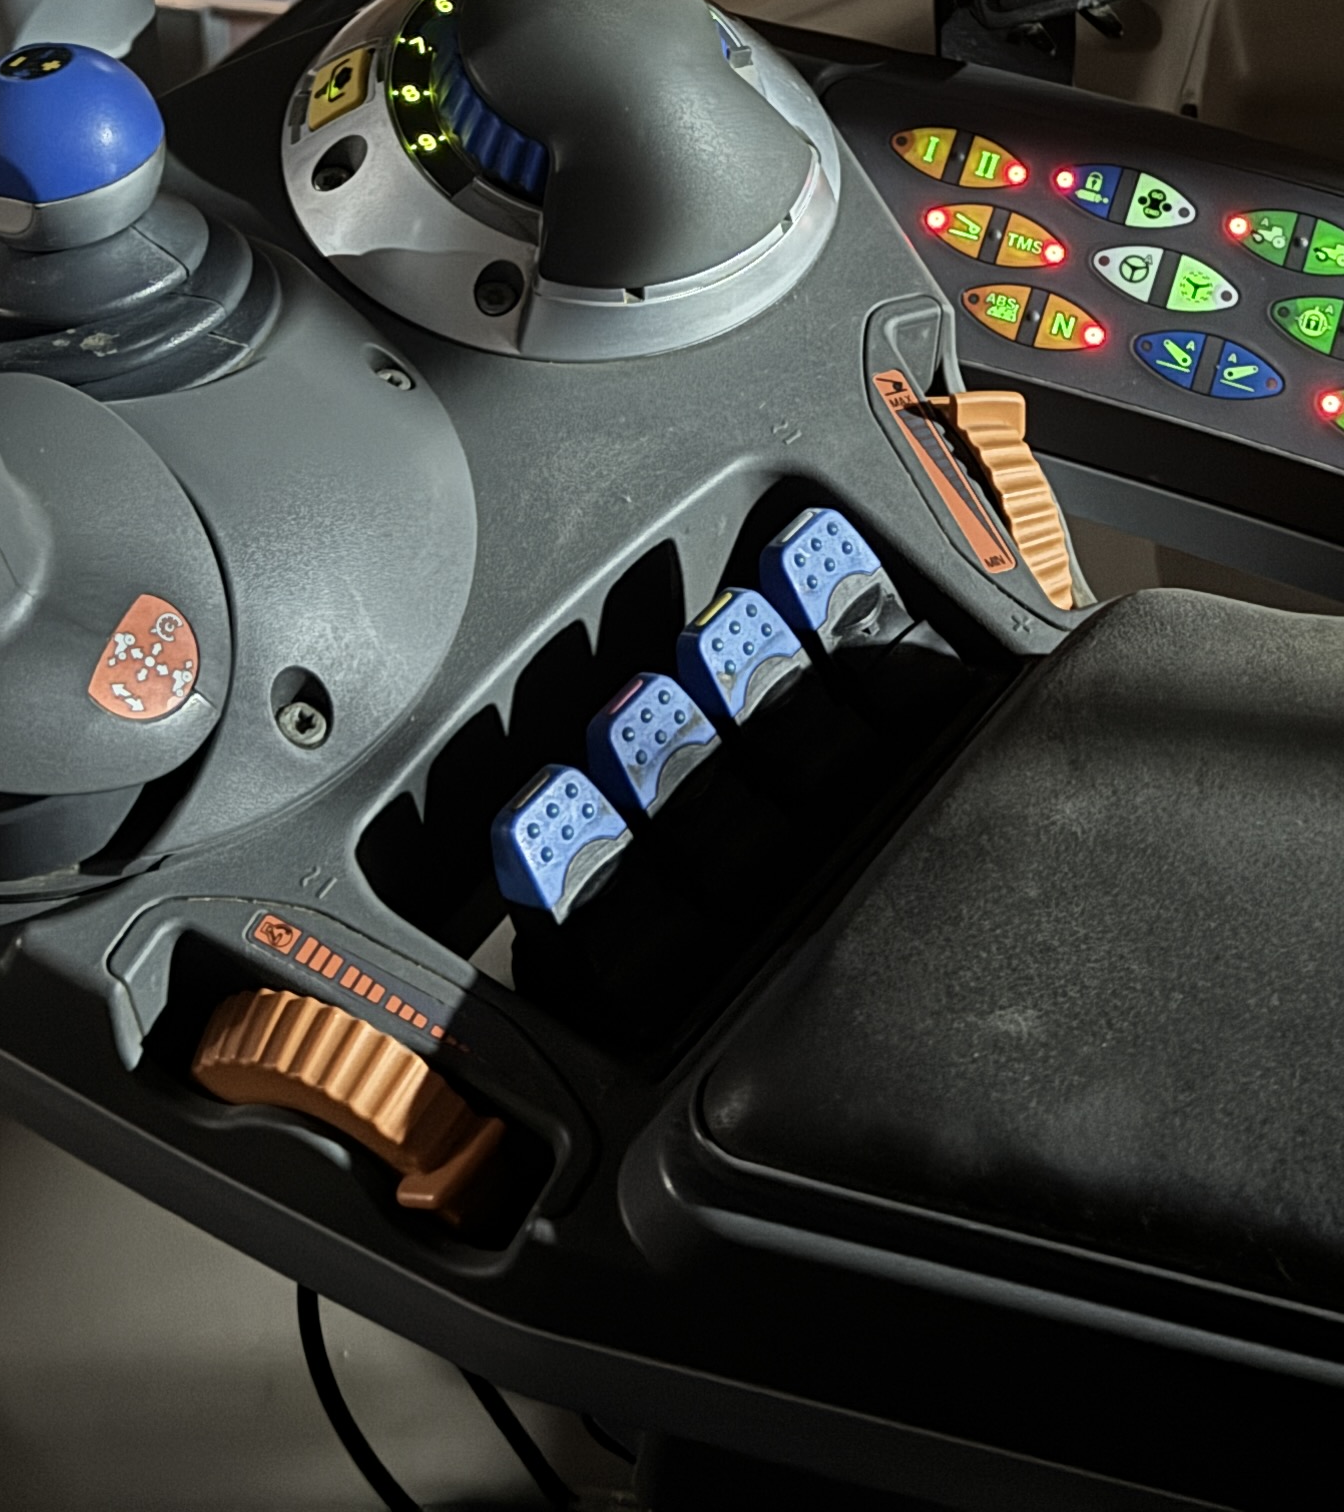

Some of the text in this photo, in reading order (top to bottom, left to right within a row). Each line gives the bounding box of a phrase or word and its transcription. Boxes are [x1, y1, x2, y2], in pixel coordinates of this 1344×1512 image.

[409, 36, 425, 54] 7
[401, 85, 421, 102] 8
[418, 133, 437, 151] 9
[1007, 231, 1042, 254] TMS
[986, 292, 1017, 311] ABS
[1051, 314, 1076, 339] N
[1186, 340, 1196, 351] A
[1227, 353, 1237, 363] A
[889, 395, 912, 408] MAX
